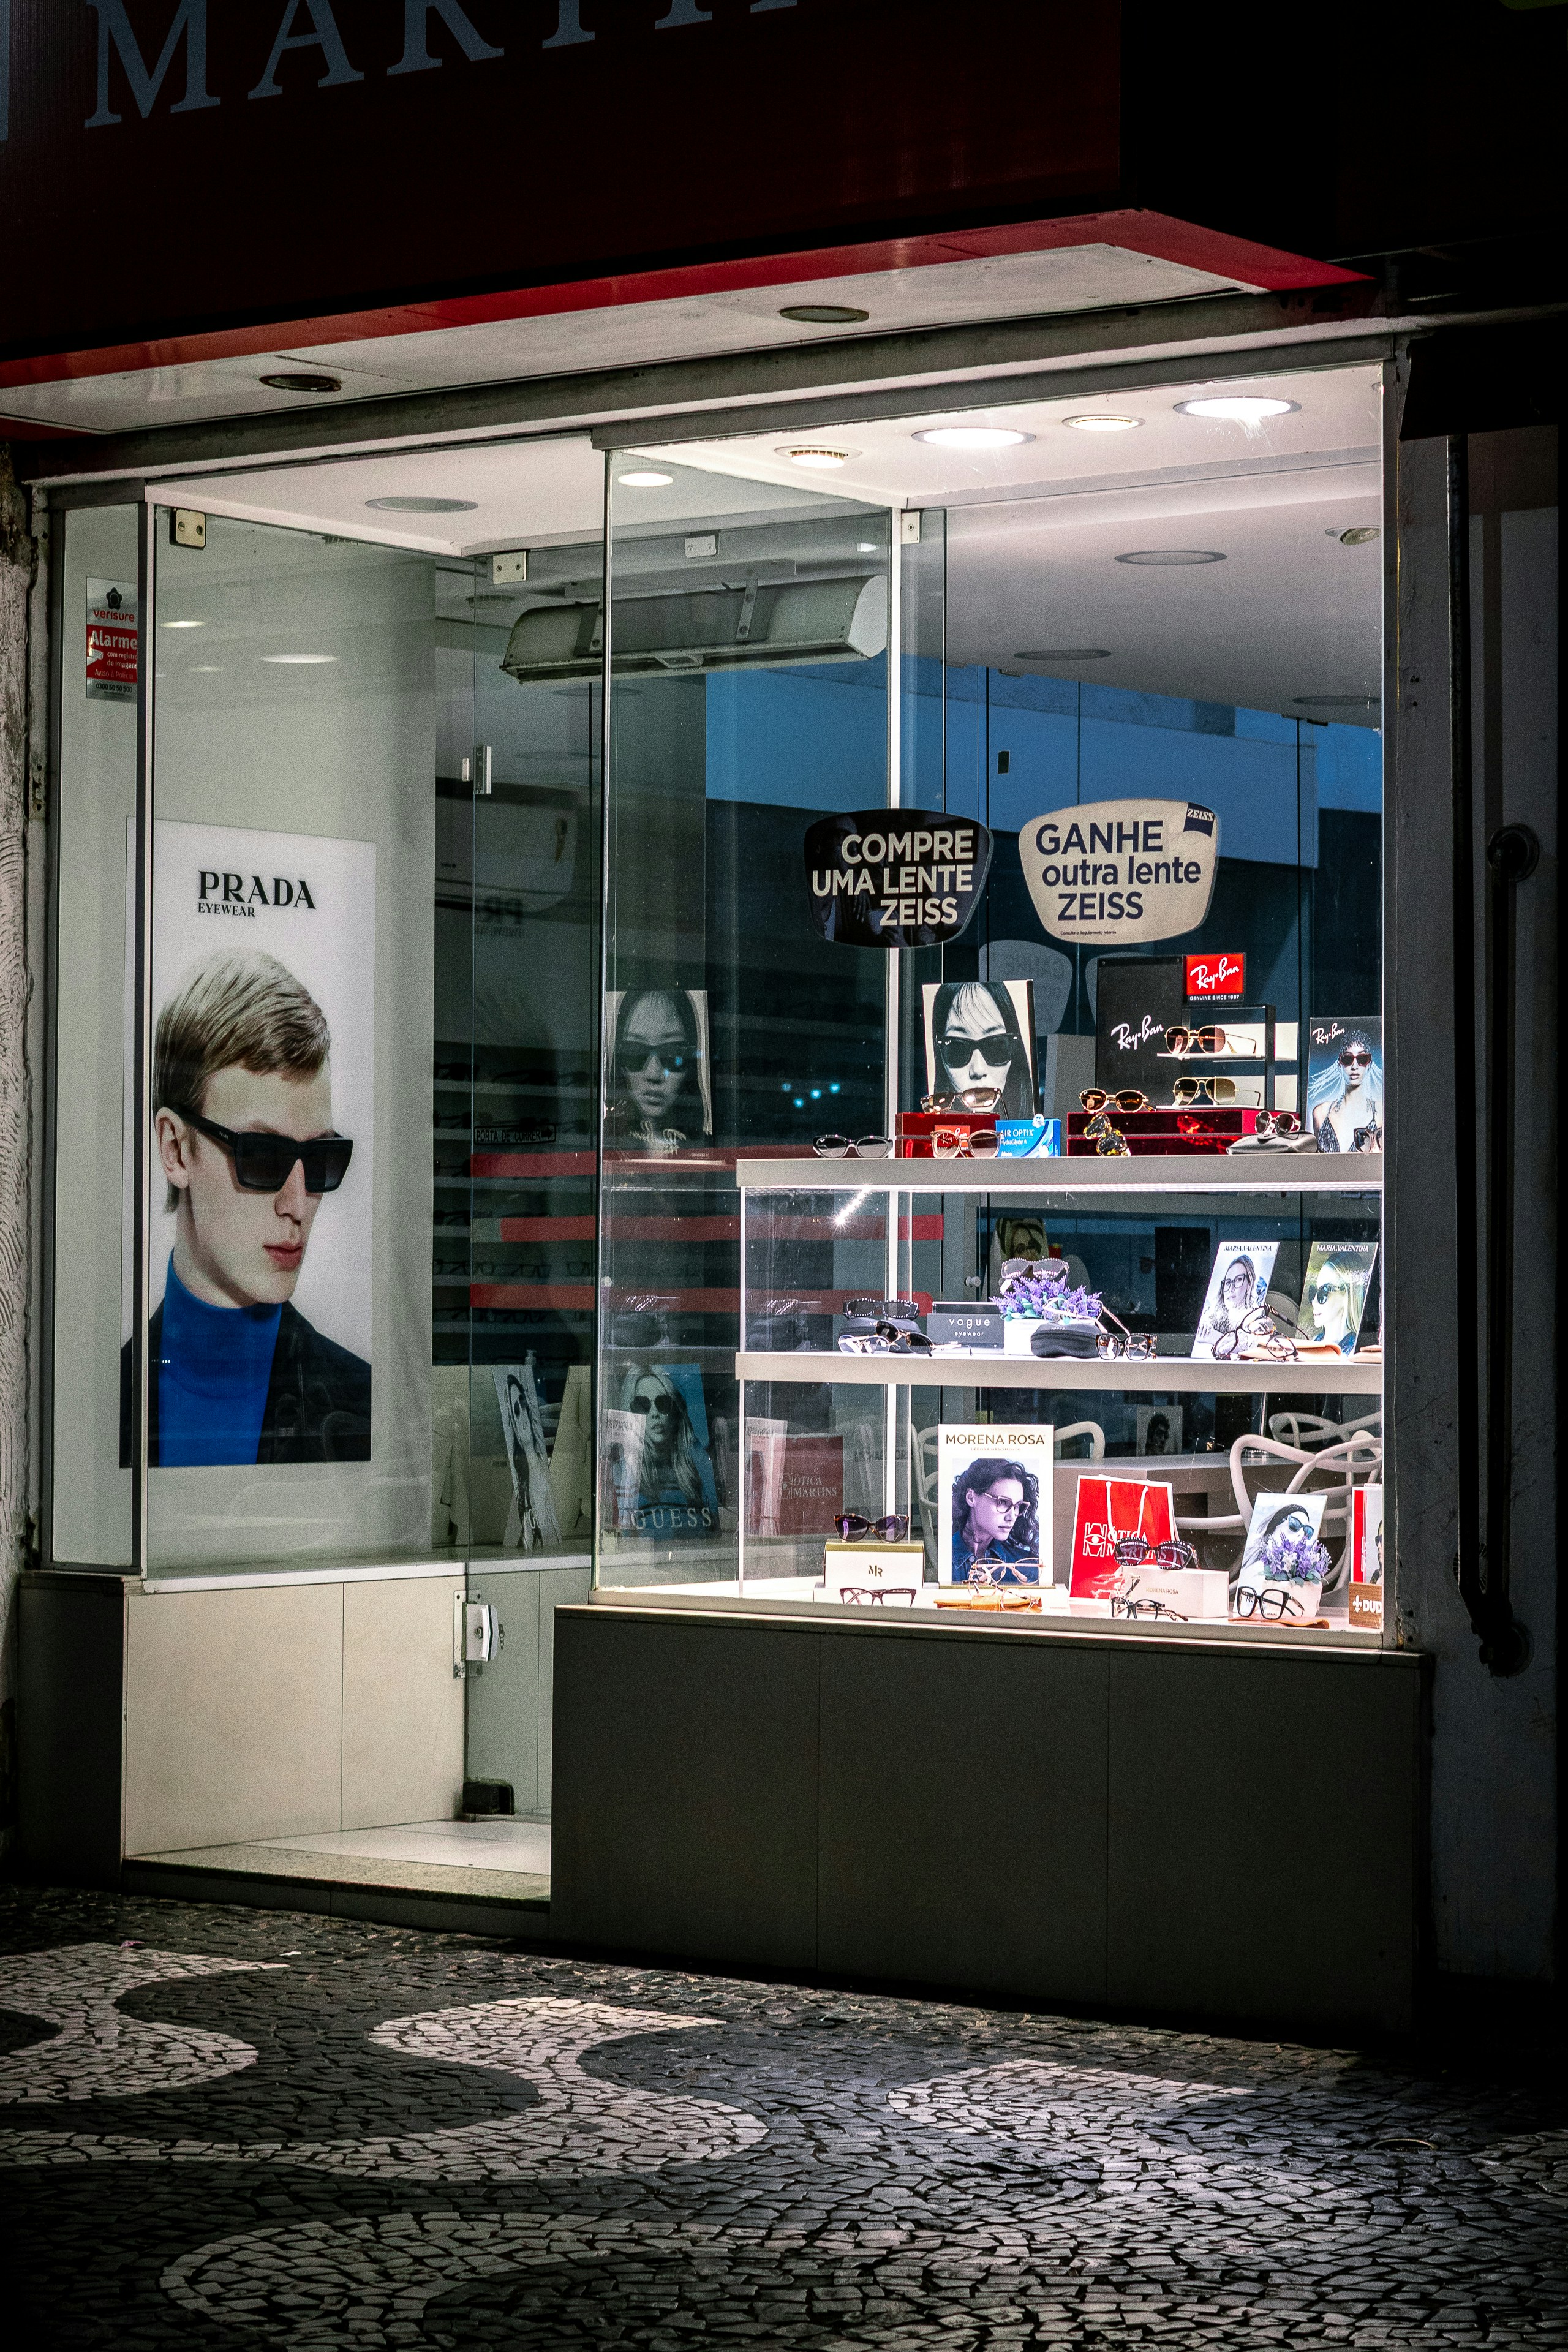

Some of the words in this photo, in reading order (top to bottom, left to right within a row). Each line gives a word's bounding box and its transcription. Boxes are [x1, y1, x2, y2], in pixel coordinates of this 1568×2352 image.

[93, 609, 135, 623] verisure
[89, 630, 137, 650] Alarme
[1186, 809, 1214, 822] ZEISS
[841, 829, 974, 864] COMPRE
[1036, 820, 1164, 856] GANHE
[812, 868, 876, 897] UMA
[883, 864, 973, 894] LENTE
[1042, 859, 1118, 888] outra
[1128, 855, 1202, 886] lente
[198, 870, 316, 910] PRADA
[198, 902, 255, 918] EYEWEAR
[880, 897, 958, 927] ZEISS
[1057, 891, 1144, 921] ZEISS
[476, 1129, 499, 1142] PORTA
[502, 1129, 510, 1142] DE
[949, 1318, 990, 1329] vogue
[946, 1434, 1005, 1445] MORENA
[1008, 1434, 1044, 1445] ROSA
[793, 1487, 837, 1498] MARTINS
[631, 1506, 712, 1531] GUESS
